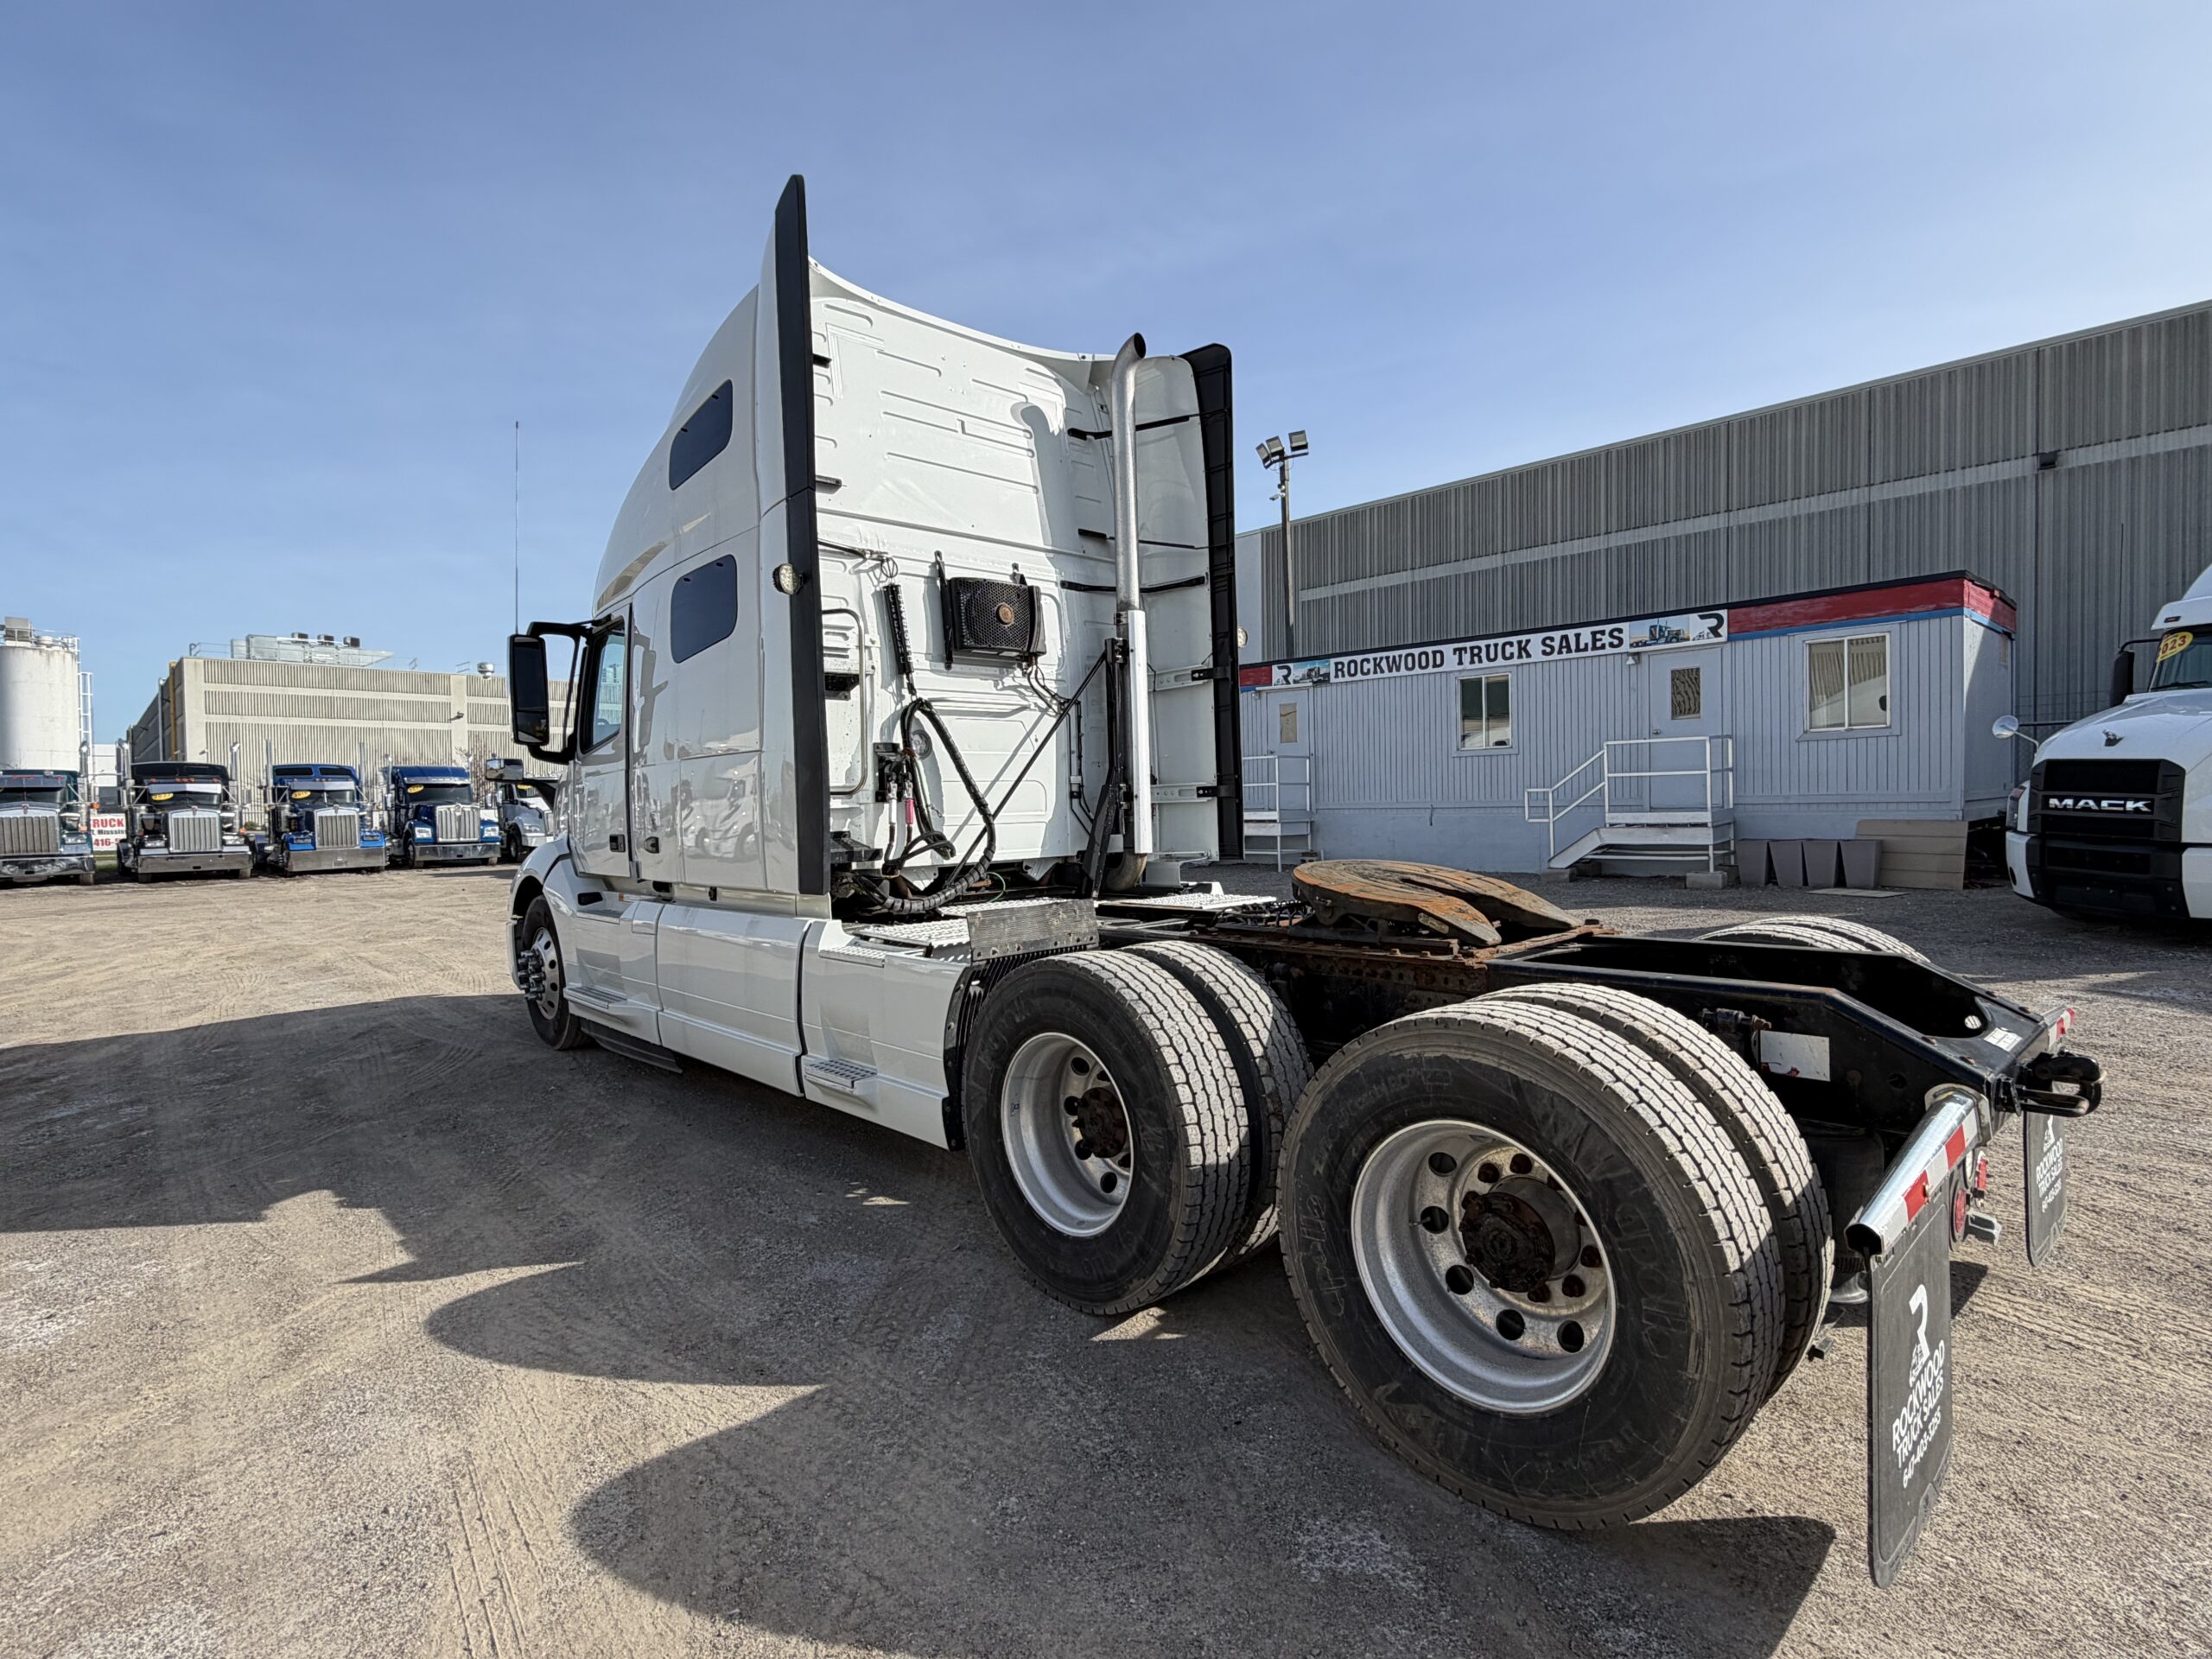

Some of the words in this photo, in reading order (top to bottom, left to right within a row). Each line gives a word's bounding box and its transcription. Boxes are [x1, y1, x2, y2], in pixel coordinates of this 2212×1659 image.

[1333, 650, 1445, 678] ROCKWOOD
[1452, 639, 1532, 666] TRUCK
[1541, 627, 1624, 657] SALES
[2161, 635, 2187, 655] 023
[91, 817, 124, 828] RUCK
[2049, 798, 2152, 812] MACK
[2036, 1137, 2063, 1185] ROCKWOOD
[1892, 1339, 1945, 1452] ROCKWOOD
[1897, 1407, 1923, 1469] TRUCK
[1923, 1370, 1943, 1421] SALES
